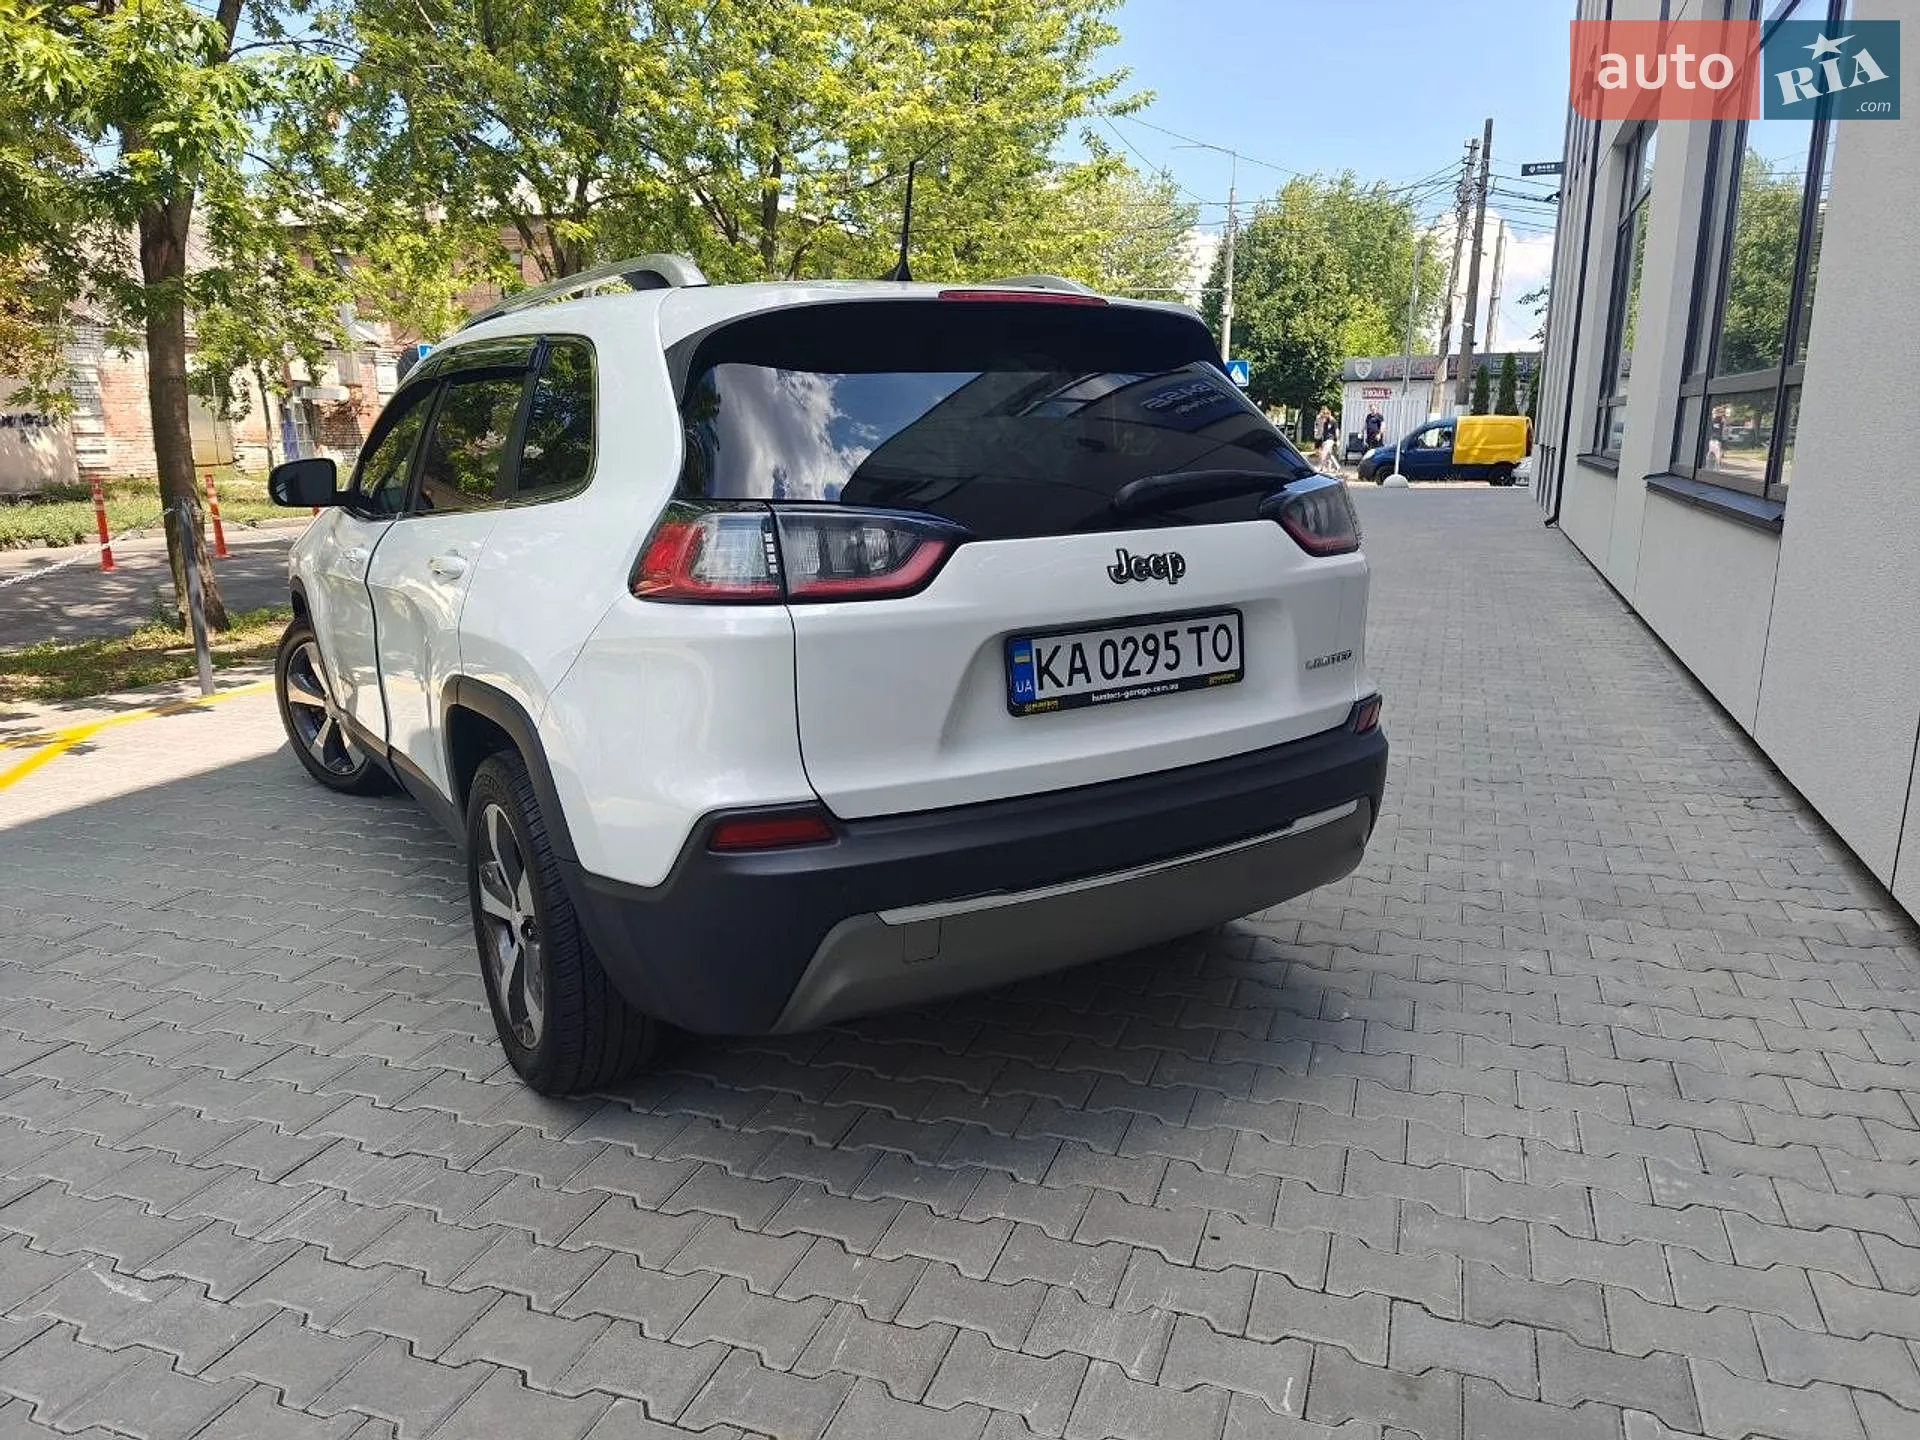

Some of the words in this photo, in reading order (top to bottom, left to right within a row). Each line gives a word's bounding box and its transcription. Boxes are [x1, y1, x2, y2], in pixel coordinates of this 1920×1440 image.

[1107, 548, 1186, 585] Jeep
[1035, 642, 1092, 691] KA
[1100, 630, 1180, 681] 0295
[1187, 623, 1233, 667] TO
[1015, 680, 1034, 694] UA
